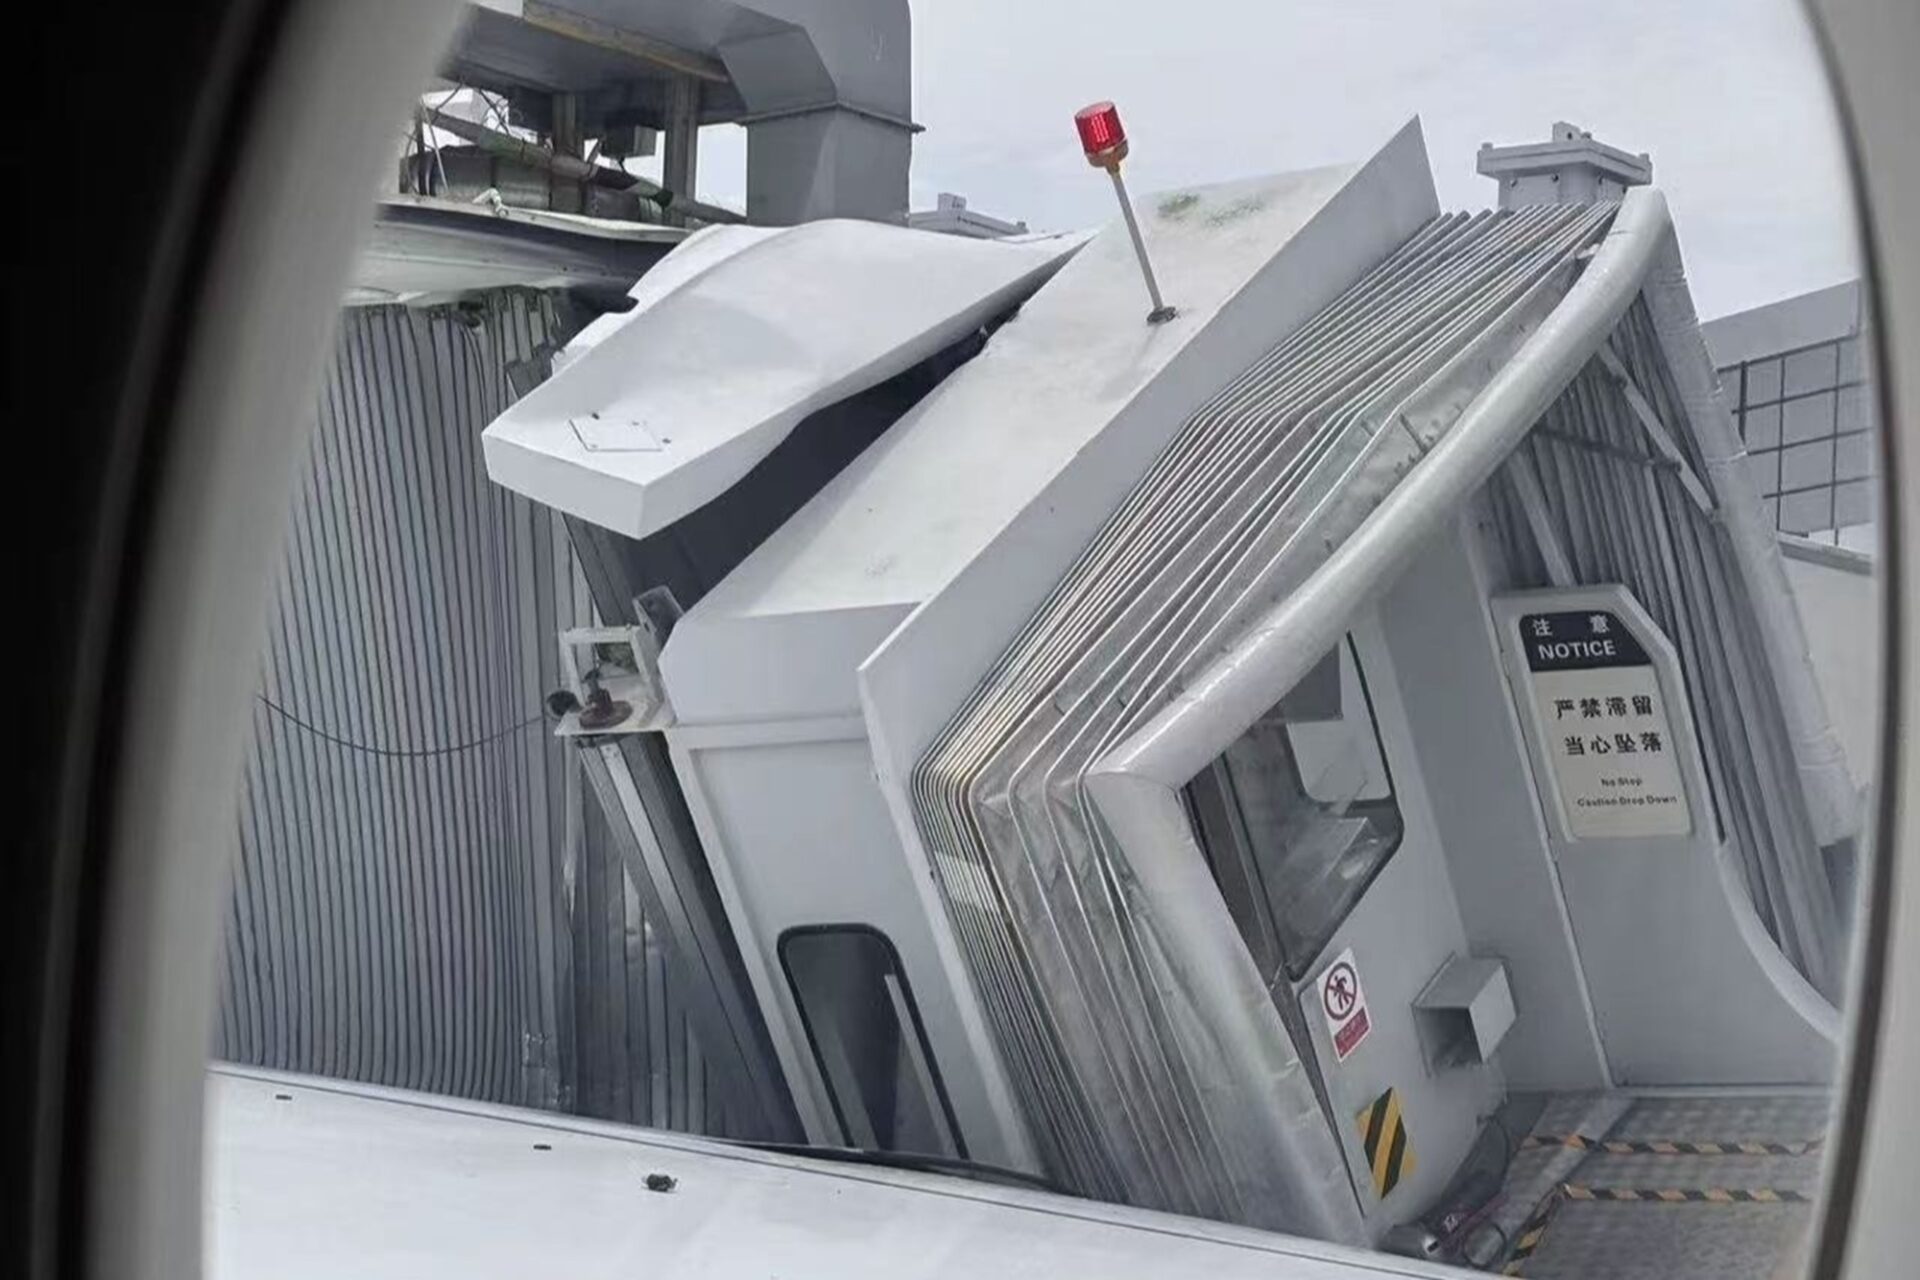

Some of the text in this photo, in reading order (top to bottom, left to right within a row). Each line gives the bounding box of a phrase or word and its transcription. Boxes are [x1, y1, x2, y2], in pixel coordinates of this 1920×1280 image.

[1532, 614, 1610, 637] 注意
[1538, 639, 1616, 660] NOTICE
[1555, 695, 1653, 719] 严禁滞留
[1565, 732, 1663, 756] 当心坠落
[1646, 794, 1678, 804] Down
